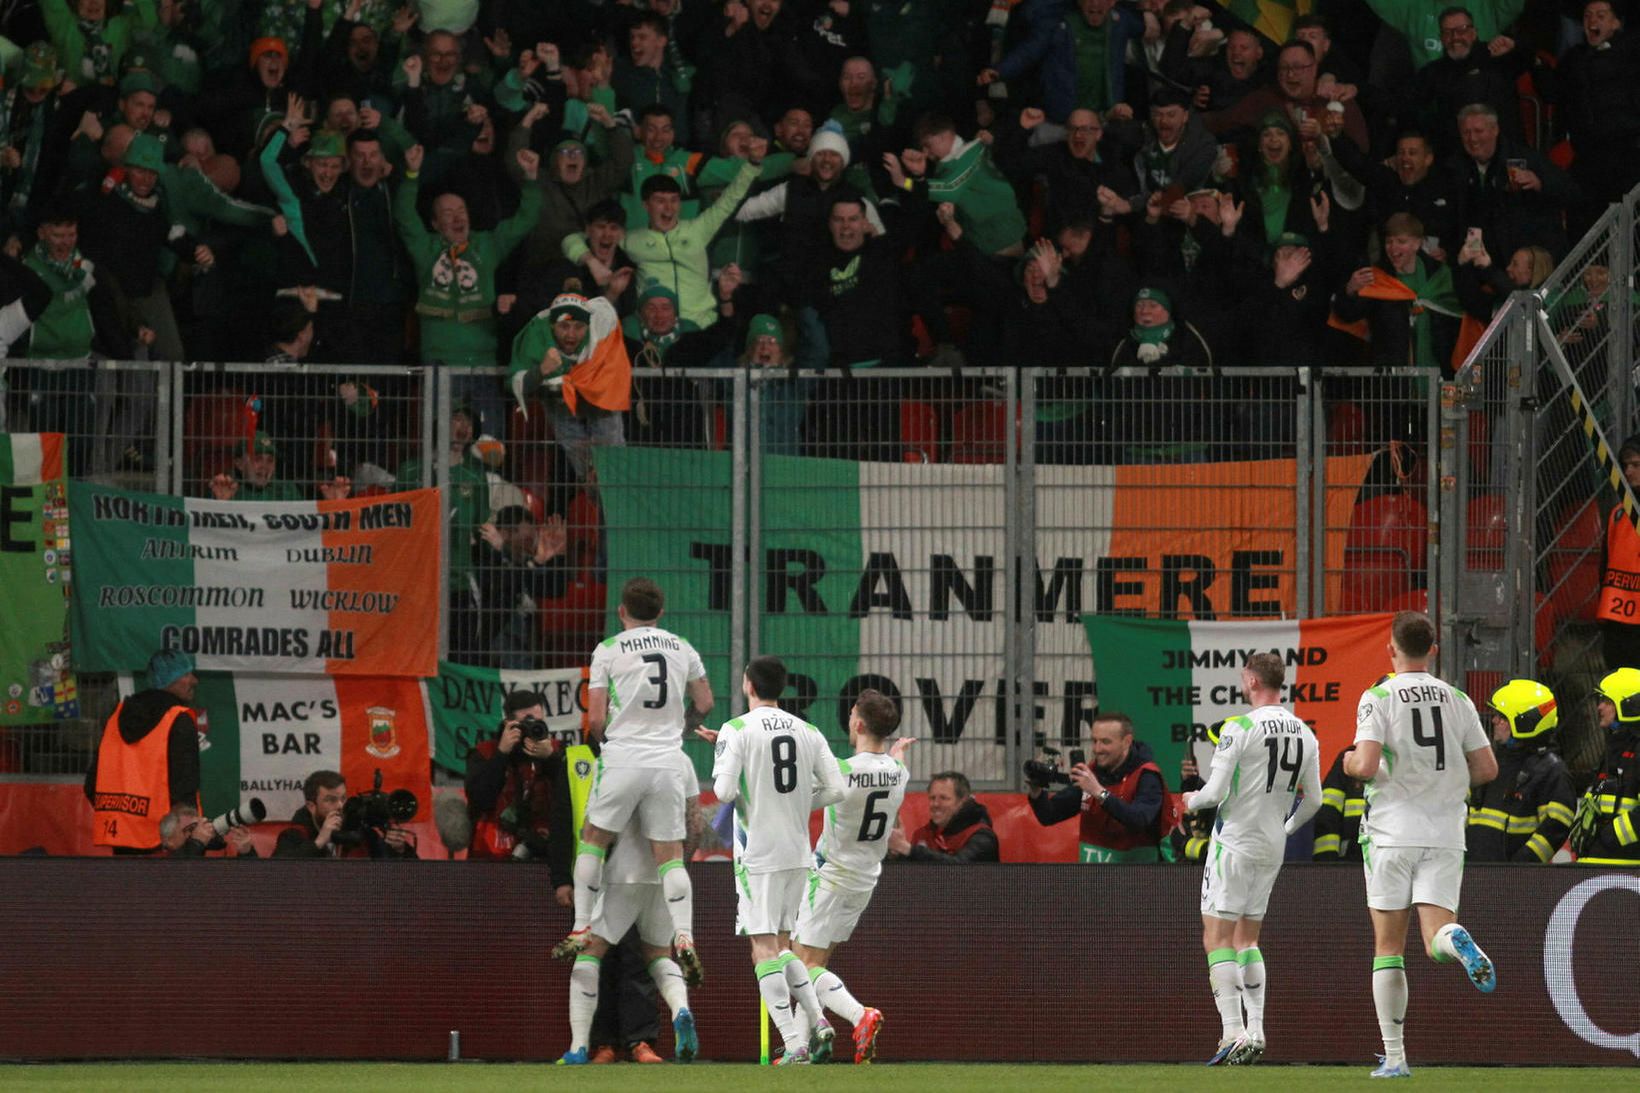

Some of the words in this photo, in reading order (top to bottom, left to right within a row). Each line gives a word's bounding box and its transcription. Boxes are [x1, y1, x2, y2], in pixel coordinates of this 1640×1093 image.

[359, 502, 412, 530] MEN
[690, 542, 1284, 624] TRANMERE
[1610, 596, 1636, 617] 20
[162, 625, 308, 658] COMRADES
[315, 628, 355, 660] ALL
[620, 635, 680, 654] MANNING
[1162, 648, 1256, 669] JIMMY
[641, 653, 668, 709] 3
[1147, 686, 1201, 706] THE
[1210, 682, 1341, 706] CHKLE
[242, 700, 337, 722] MAC'S
[262, 733, 322, 755] BAR
[1411, 706, 1445, 771] 4
[771, 735, 798, 794] 8
[1264, 736, 1304, 794] 14
[857, 790, 890, 842] 6
